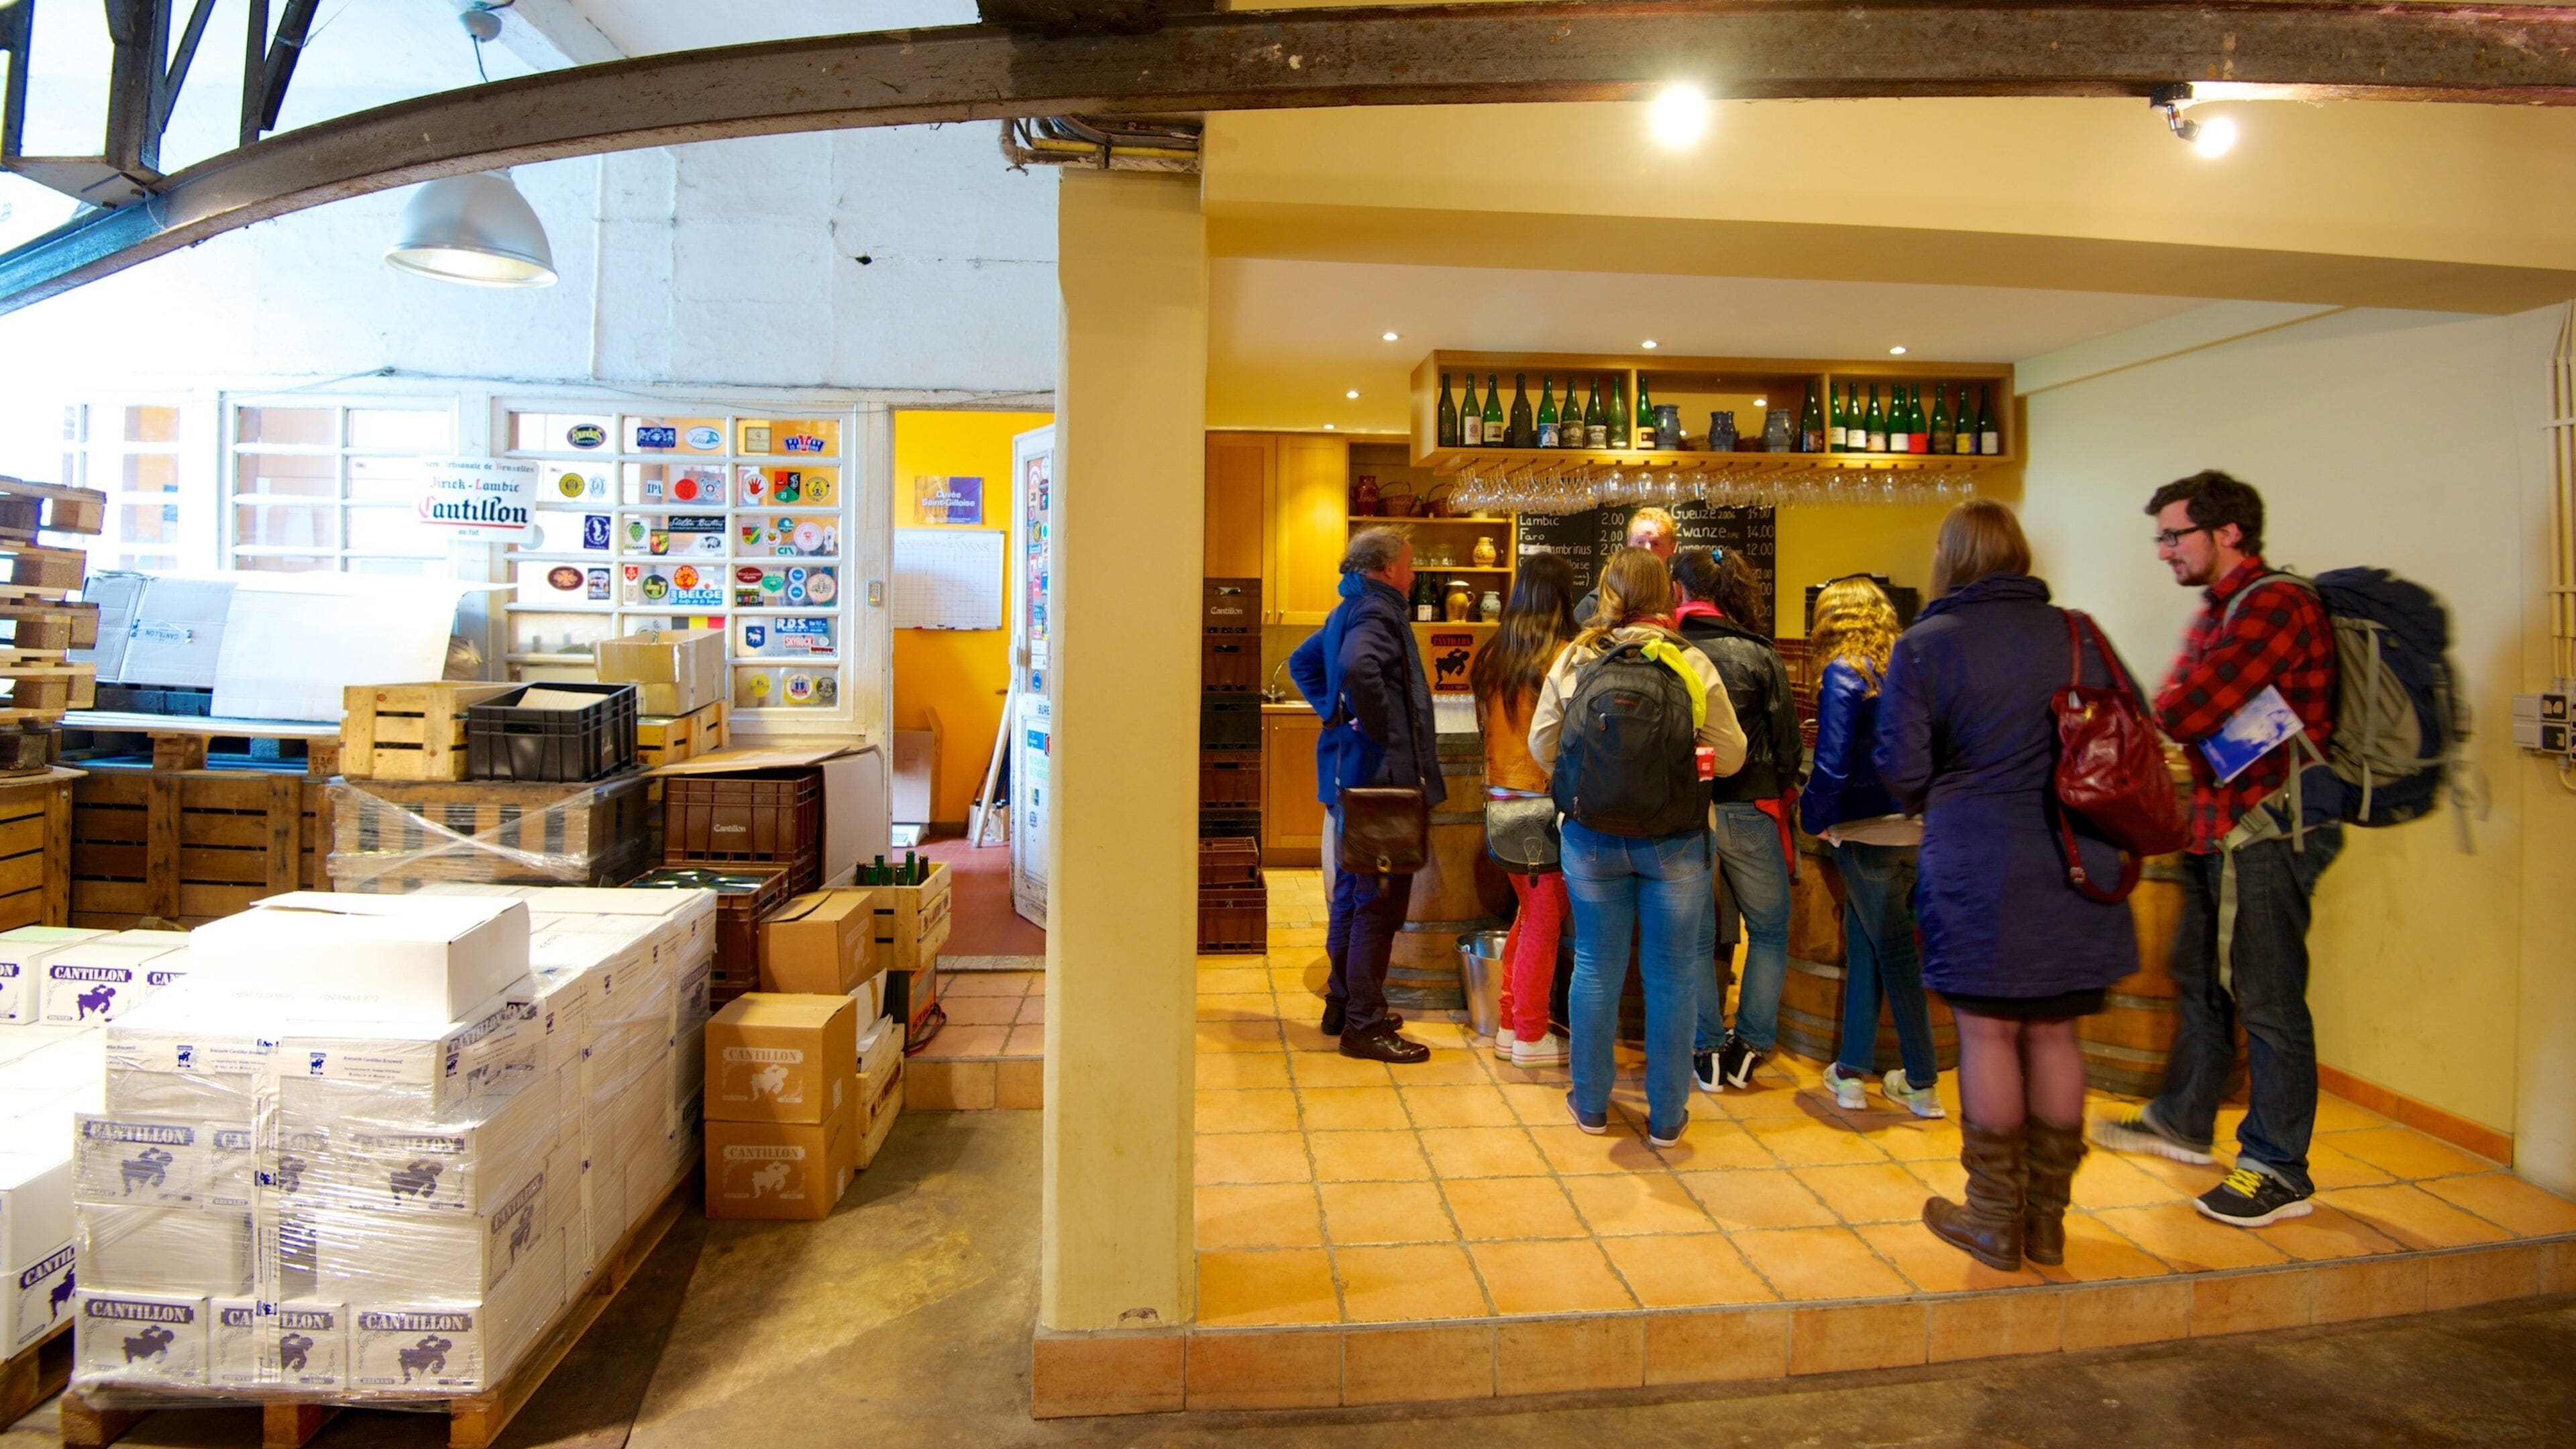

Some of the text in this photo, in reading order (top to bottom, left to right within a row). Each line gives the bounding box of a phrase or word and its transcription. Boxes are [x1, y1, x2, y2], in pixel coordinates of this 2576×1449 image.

[936, 490, 961, 498] Cuvée
[922, 498, 975, 506] Saint-Gilloise
[419, 495, 528, 523] Cantillon
[1671, 504, 1717, 520] Gueuze
[1519, 513, 1625, 526] Lambic 2.00
[1519, 528, 1623, 543] Faro 2.00
[1674, 523, 1727, 539] Zwanze
[1747, 543, 1774, 555] 12.00
[678, 590, 722, 599] BELGE
[1210, 606, 1243, 615] Cantillon
[713, 824, 747, 833] Cantillon
[54, 967, 127, 981] CANTILLON
[729, 1049, 797, 1061] CANTILLON
[90, 1123, 186, 1144] CANTILLON
[730, 1146, 798, 1159] CANTILLON
[91, 1301, 186, 1322] CANTILLON
[366, 1313, 464, 1330] CANTILLON
